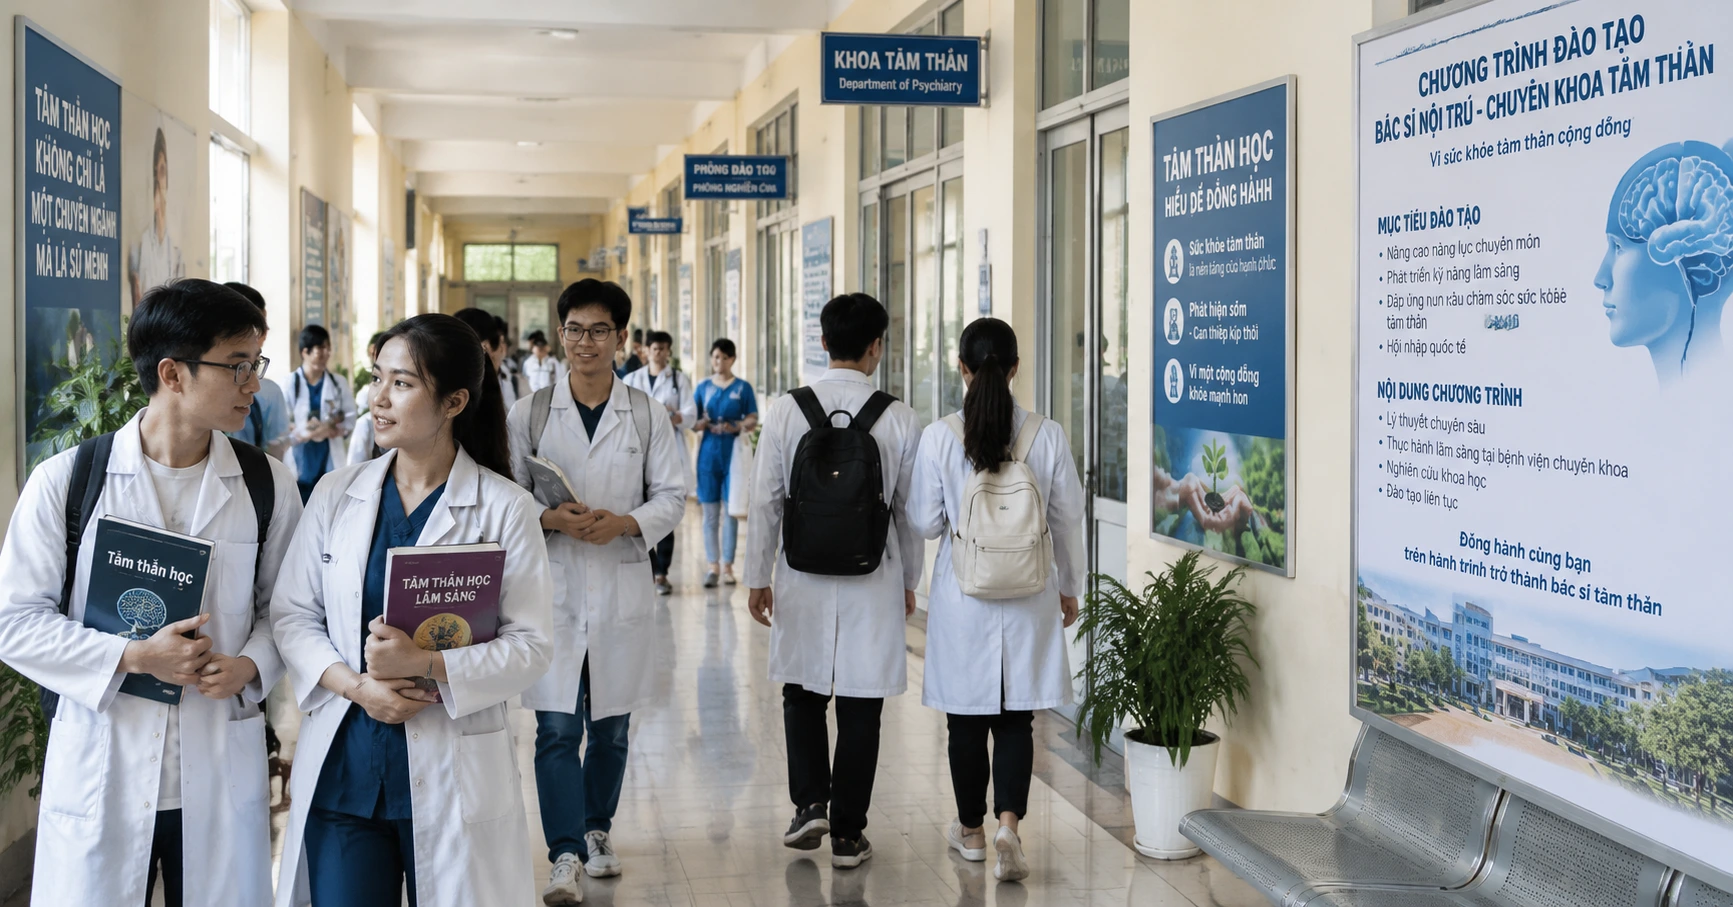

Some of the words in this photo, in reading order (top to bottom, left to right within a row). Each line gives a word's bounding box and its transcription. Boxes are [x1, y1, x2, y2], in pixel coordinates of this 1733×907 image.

[834, 50, 880, 70] KHOA
[1418, 55, 1488, 98] CHƯƠNG
[1492, 39, 1548, 78] TRÌNH
[1553, 26, 1596, 63] ĐÀO
[1602, 14, 1644, 54] TẠO
[839, 77, 896, 91] Department
[899, 79, 909, 90] of
[1375, 113, 1400, 144] BÁC
[1446, 95, 1472, 128] TRÚ
[1554, 70, 1604, 106] KHOA
[1240, 129, 1274, 172] HỌC
[1378, 214, 1400, 236] MỤC
[1430, 206, 1454, 229] ĐÀO
[1412, 246, 1429, 258] cao
[1377, 377, 1396, 403] NỘI
[1399, 382, 1429, 401] DUNG
[1432, 383, 1481, 404] CHƯƠNG
[1485, 383, 1522, 407] TRÌNH
[1482, 448, 1495, 466] tại
[1599, 459, 1628, 478] khoa
[1441, 468, 1465, 485] khoa
[1468, 471, 1487, 491] học
[1406, 488, 1421, 505] tạo
[1443, 494, 1458, 511] tục
[1565, 552, 1591, 575] bạn
[169, 566, 194, 586] học
[467, 575, 491, 588] HỌC
[1551, 576, 1575, 597] bác
